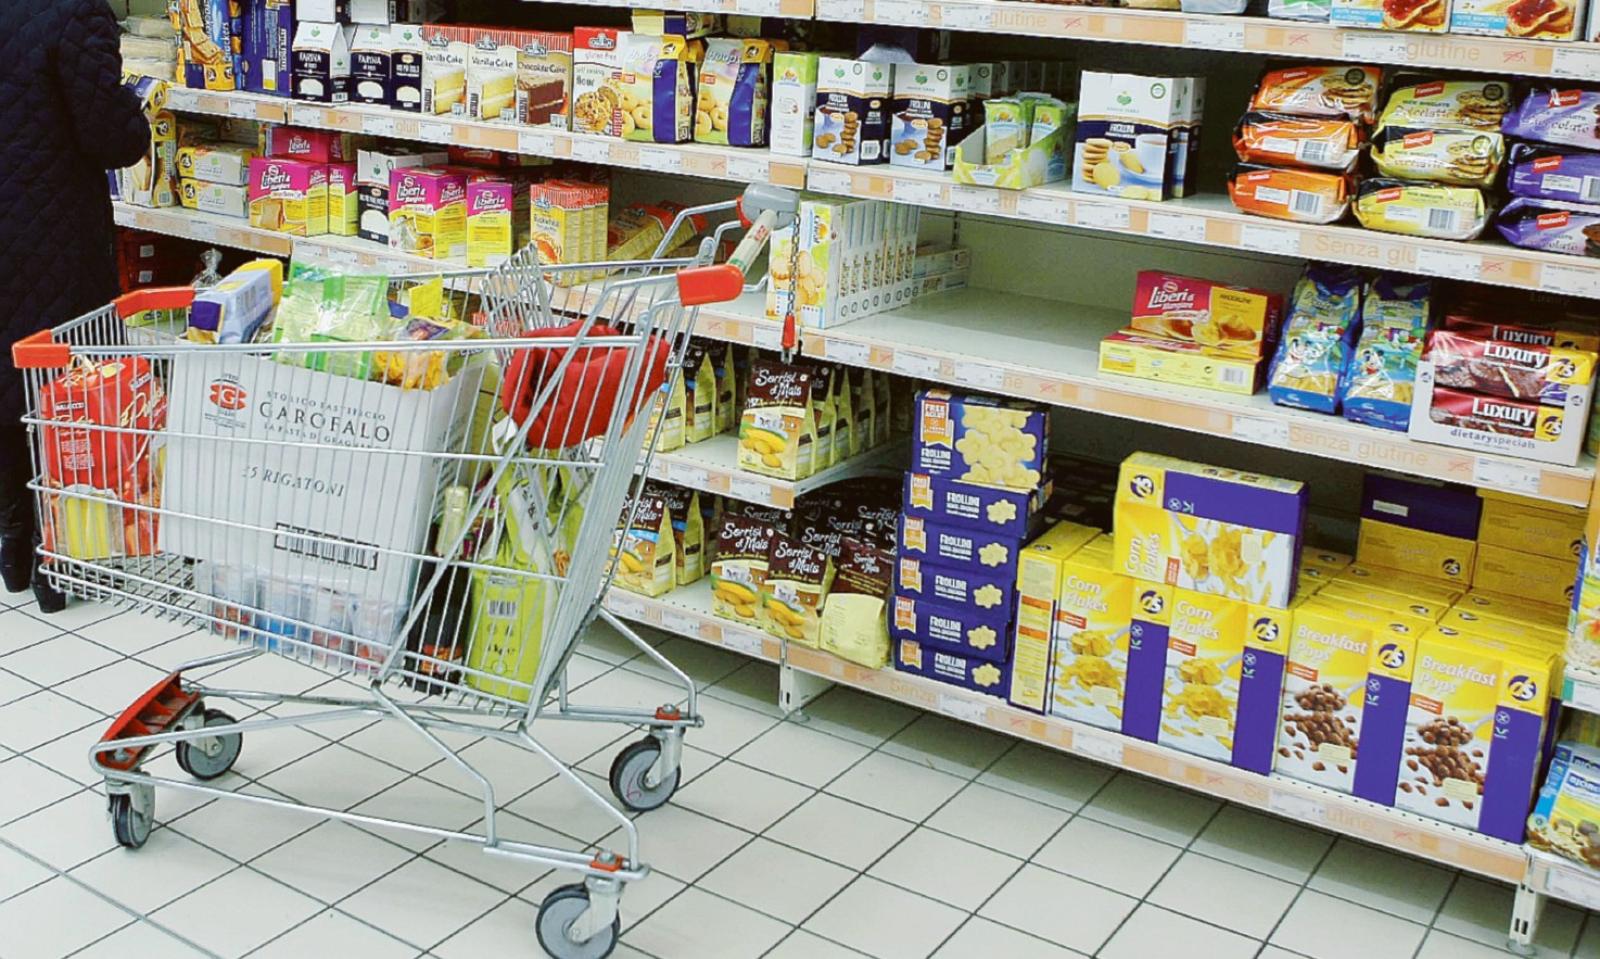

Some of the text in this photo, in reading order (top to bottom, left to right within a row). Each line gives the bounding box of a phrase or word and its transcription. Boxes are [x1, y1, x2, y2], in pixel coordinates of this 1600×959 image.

[426, 53, 463, 65] Vanilla Cake
[1406, 38, 1480, 62] glutine
[472, 56, 495, 67] Vanilla
[261, 170, 285, 190] Liberi
[396, 182, 421, 201] Liberi
[473, 195, 500, 210] Liberi
[1314, 234, 1379, 259] Senza
[1147, 286, 1188, 309] Liberi
[1492, 325, 1552, 346] Luxury
[1484, 340, 1547, 368] Luxury
[755, 368, 798, 387] Sorrisi
[777, 381, 802, 399] Mais
[1472, 397, 1536, 426] Luxury
[260, 401, 390, 443] GAROFALO
[1289, 427, 1429, 467] Senza glutine
[1450, 427, 1537, 450] dietaryspecials
[263, 469, 345, 497] RIGATONI
[722, 523, 762, 539] Sorrisi
[802, 527, 842, 545] Sorrisi
[742, 537, 769, 553] Mais
[775, 542, 814, 560] Sorrisi
[1125, 537, 1142, 574] Corn
[793, 558, 819, 574] Mais
[1067, 575, 1102, 594] Corn
[1176, 600, 1213, 620] Corn
[1297, 624, 1369, 656] Breakfast
[1295, 642, 1329, 662] Pops
[1422, 655, 1497, 687] Breakfast
[1419, 672, 1457, 695] Pops
